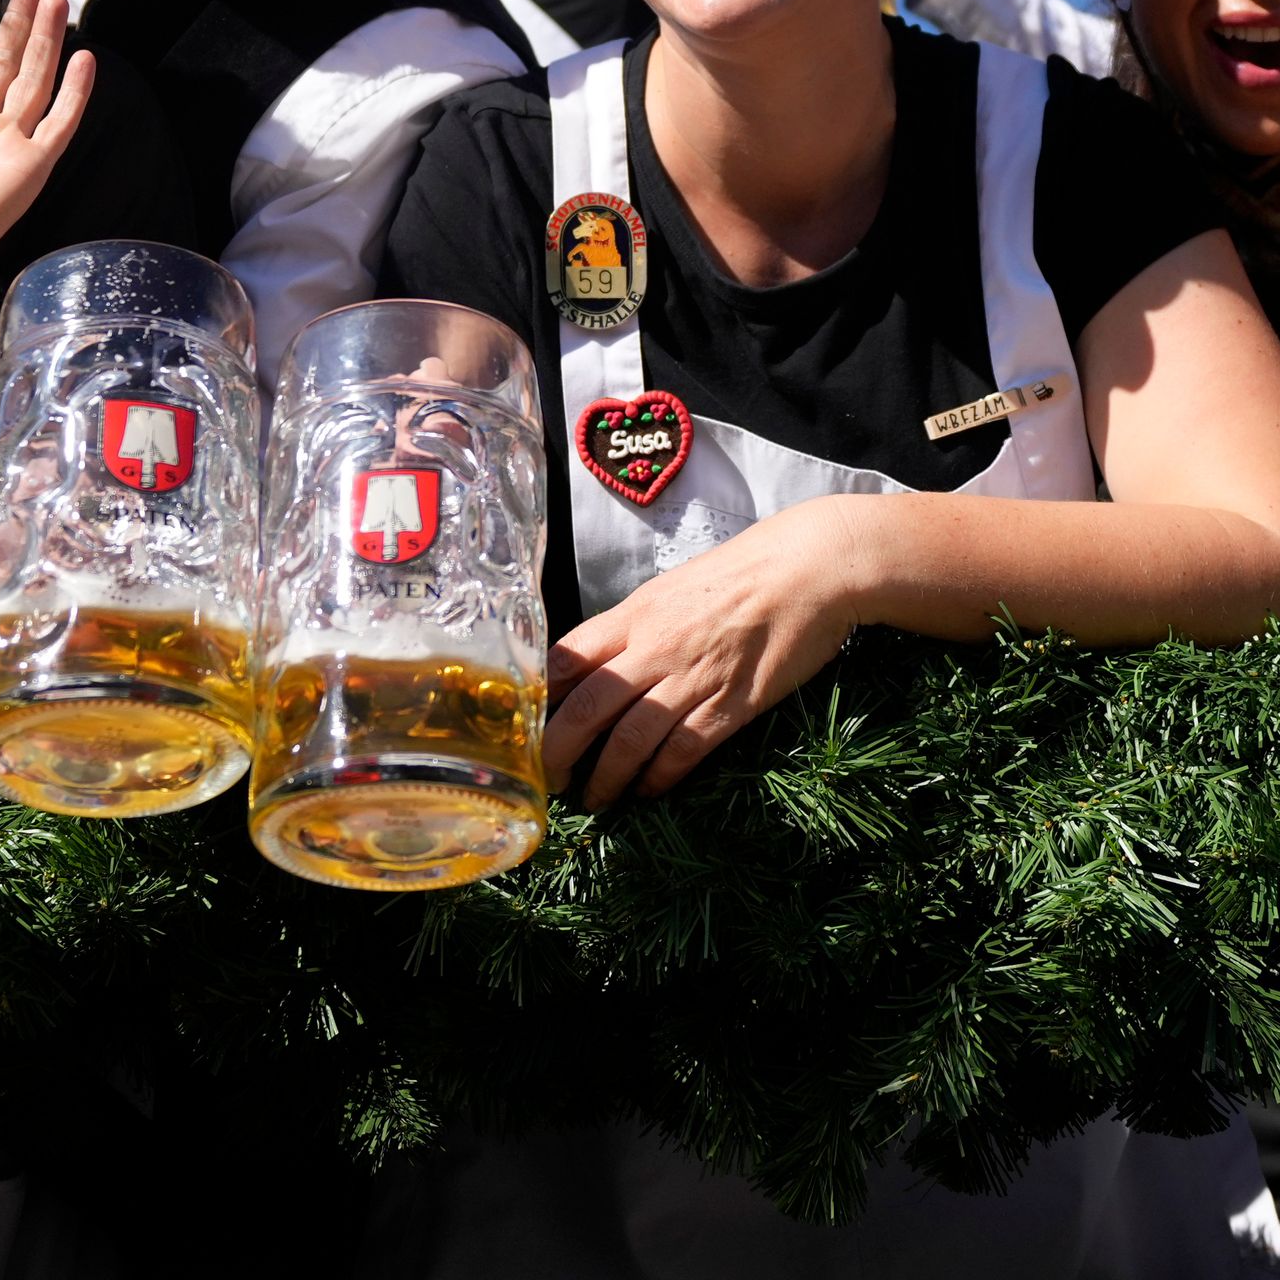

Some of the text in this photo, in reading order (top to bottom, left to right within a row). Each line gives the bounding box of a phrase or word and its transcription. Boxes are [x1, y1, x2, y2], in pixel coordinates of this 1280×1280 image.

[546, 193, 647, 253] SCHOTTENHAMEL
[578, 269, 613, 295] 59
[548, 291, 643, 328] FESTHALLE
[607, 429, 672, 459] Susa
[121, 465, 177, 483] G S
[362, 538, 420, 551] G S
[350, 580, 444, 601] PATEN
